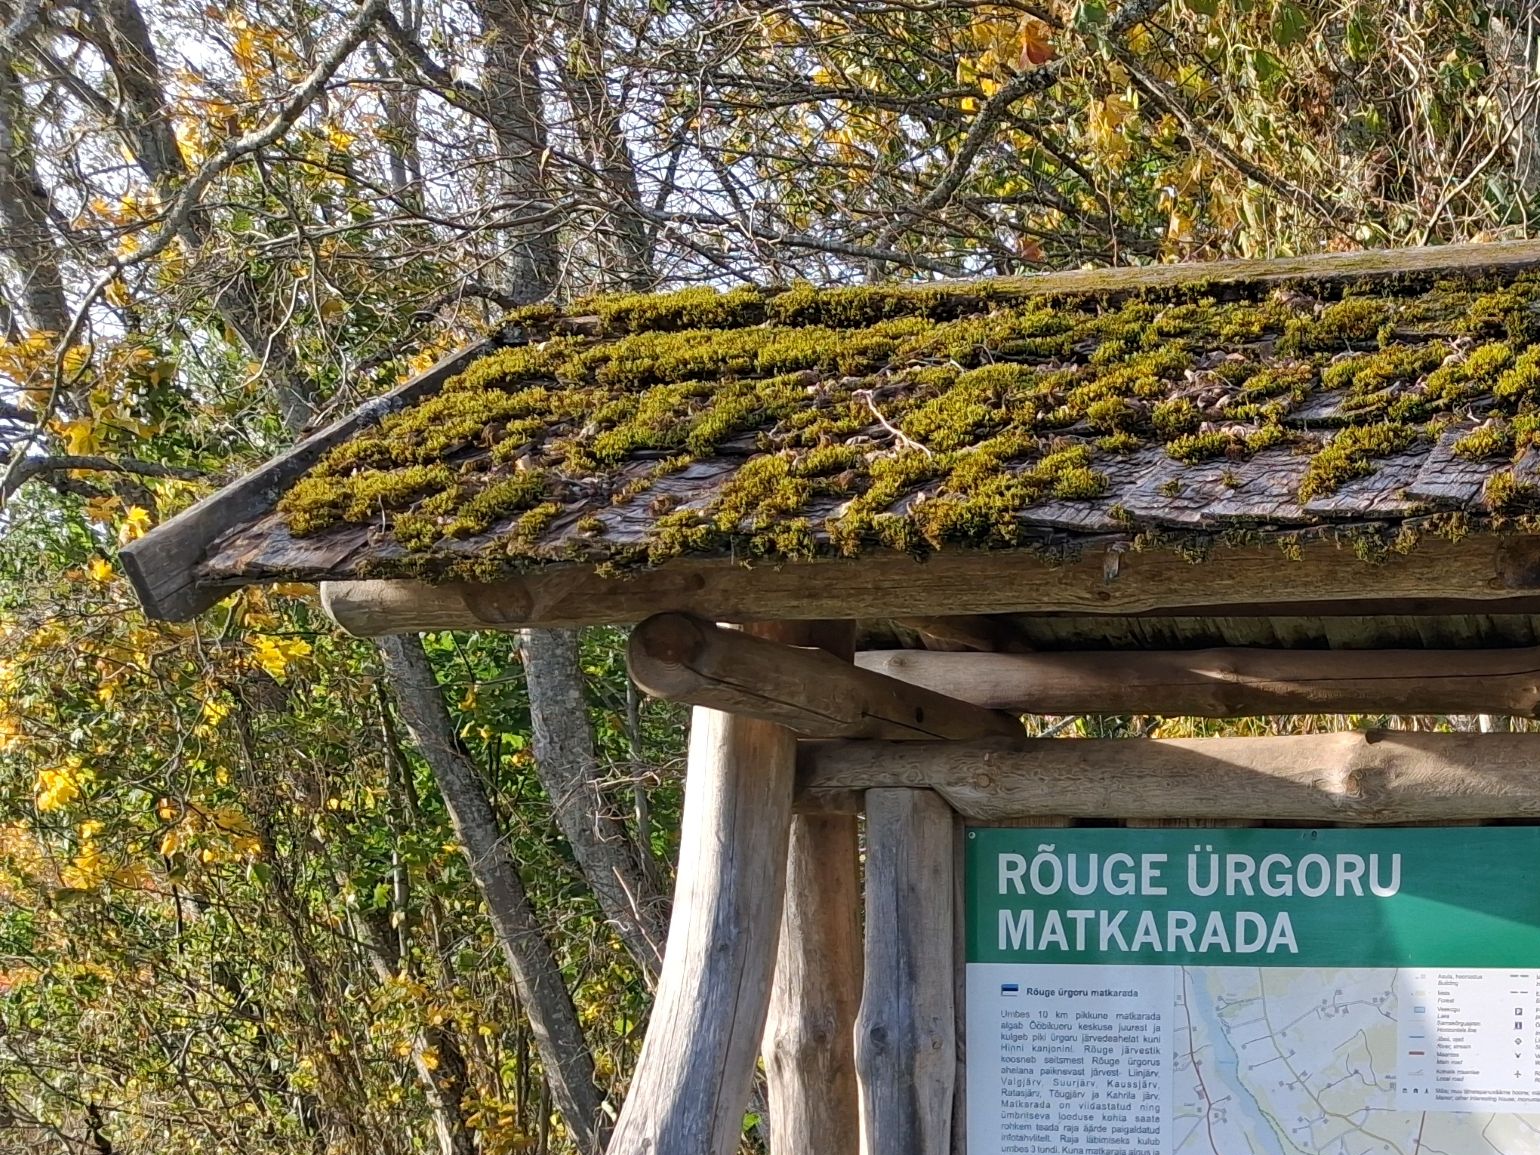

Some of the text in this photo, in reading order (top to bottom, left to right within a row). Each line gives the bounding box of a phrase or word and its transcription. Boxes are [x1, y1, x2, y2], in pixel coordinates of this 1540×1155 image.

[998, 843, 1401, 897] RÕUGE ÜRGORU
[998, 909, 1299, 953] MATKARADA
[1026, 987, 1139, 999] Rõuge ürgoru matkarada
[1001, 1010, 1161, 1021] Umbes 10 km pikkune matkarada
[1001, 1021, 1023, 1031] algab
[1078, 1022, 1113, 1031] keskuse
[1119, 1023, 1147, 1033] juurest
[1153, 1023, 1161, 1033] ja
[1001, 1033, 1028, 1043] kulgeb
[1032, 1033, 1046, 1043] piki
[1143, 1034, 1161, 1043] kuni
[1001, 1044, 1024, 1052] Hinni
[1084, 1045, 1114, 1055] Rõuge
[1122, 1046, 1160, 1056] järvestik
[1001, 1055, 1160, 1067] koosneb seitsmest Rõuge ürgorus
[1050, 1090, 1085, 1100] Tõugjärv
[1092, 1090, 1099, 1100] ja
[1107, 1091, 1136, 1099] Kahrila
[1001, 1100, 1051, 1109] Matkarada
[1079, 1101, 1132, 1110] viidastatud
[1140, 1103, 1160, 1113] ning
[1002, 1123, 1160, 1135] rohkem teada raja äärde paigaldatud
[1060, 1135, 1079, 1145] Raja
[1086, 1136, 1130, 1145] läbimiseks
[1138, 1137, 1160, 1145] kulub
